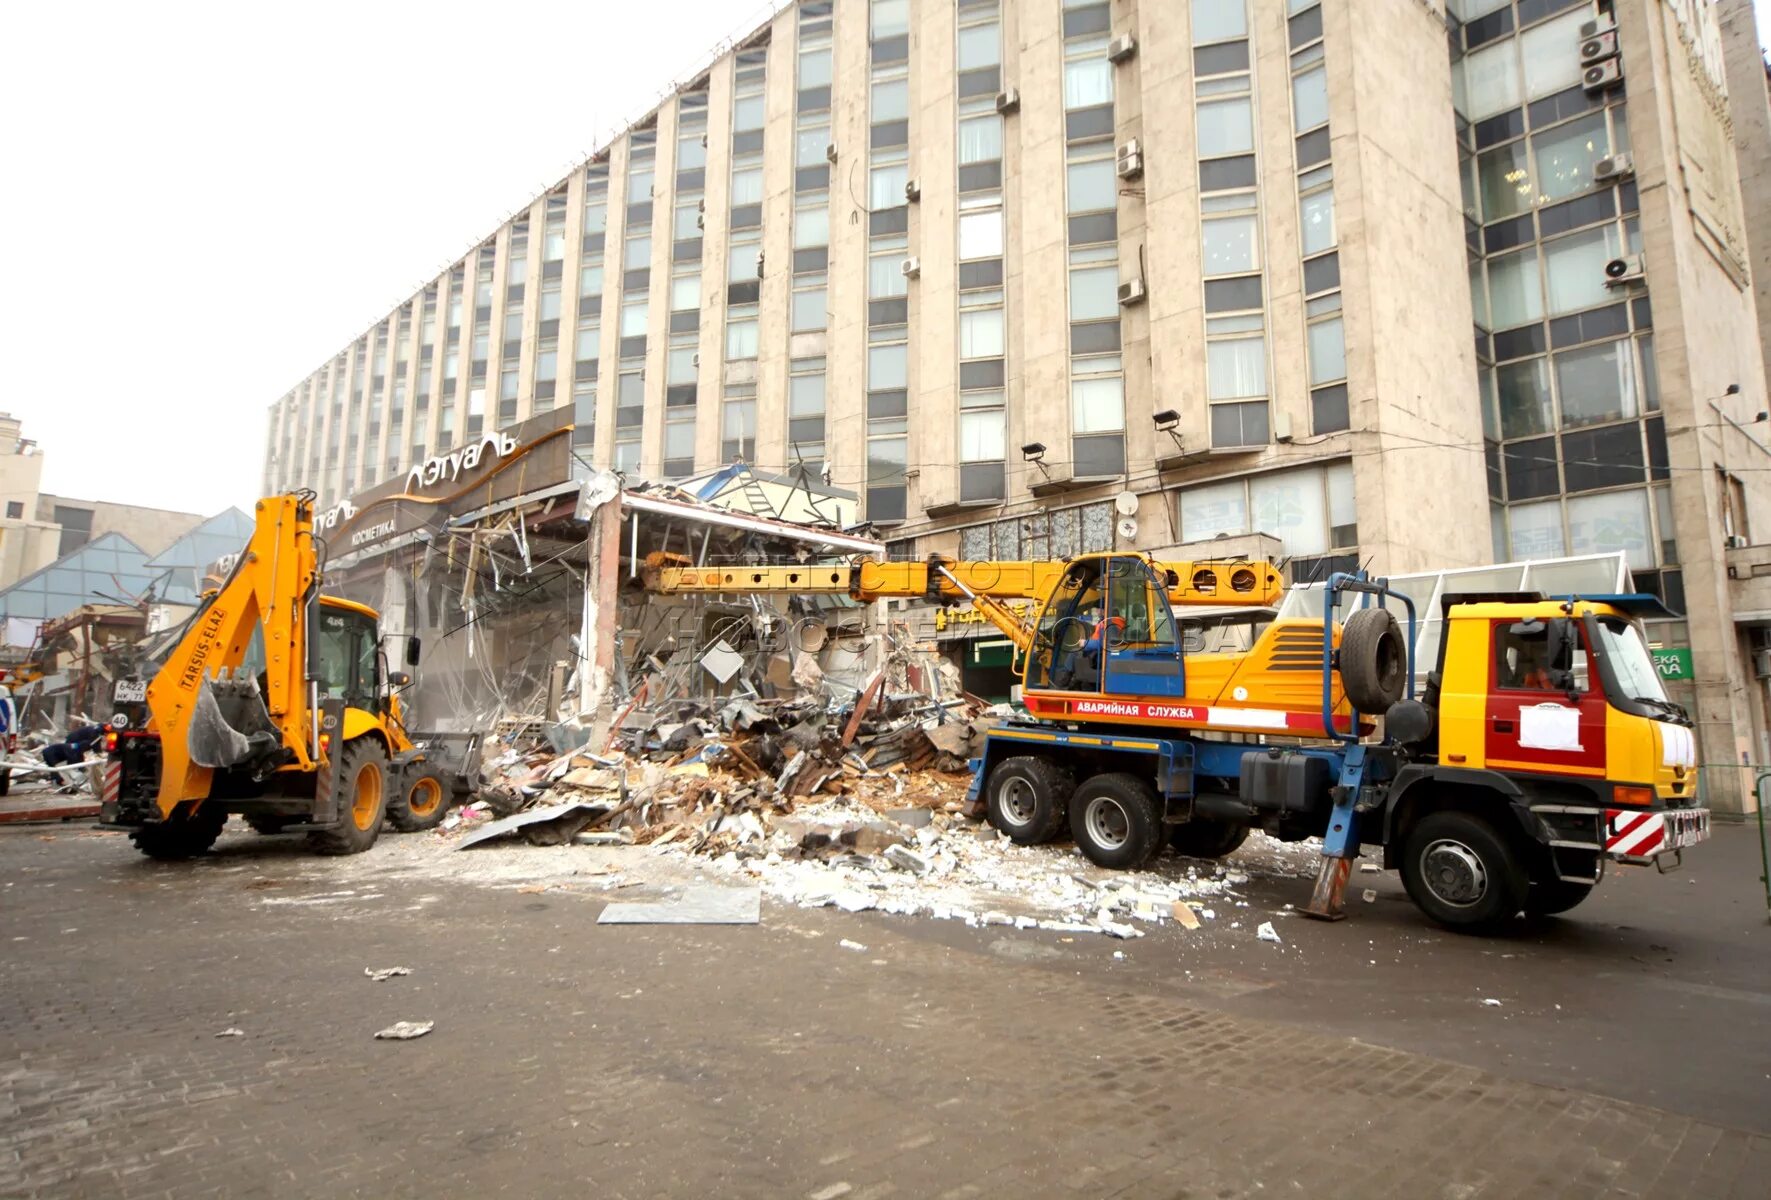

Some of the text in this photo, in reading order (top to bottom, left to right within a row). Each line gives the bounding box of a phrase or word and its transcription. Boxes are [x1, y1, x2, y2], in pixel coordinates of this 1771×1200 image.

[352, 519, 395, 546] КОСМЕТИКА
[181, 609, 225, 688] TARSUS-ELAZ
[113, 715, 126, 725] 40
[1077, 702, 1194, 719] АВАРИЙНАЯ СЛУЖБА
